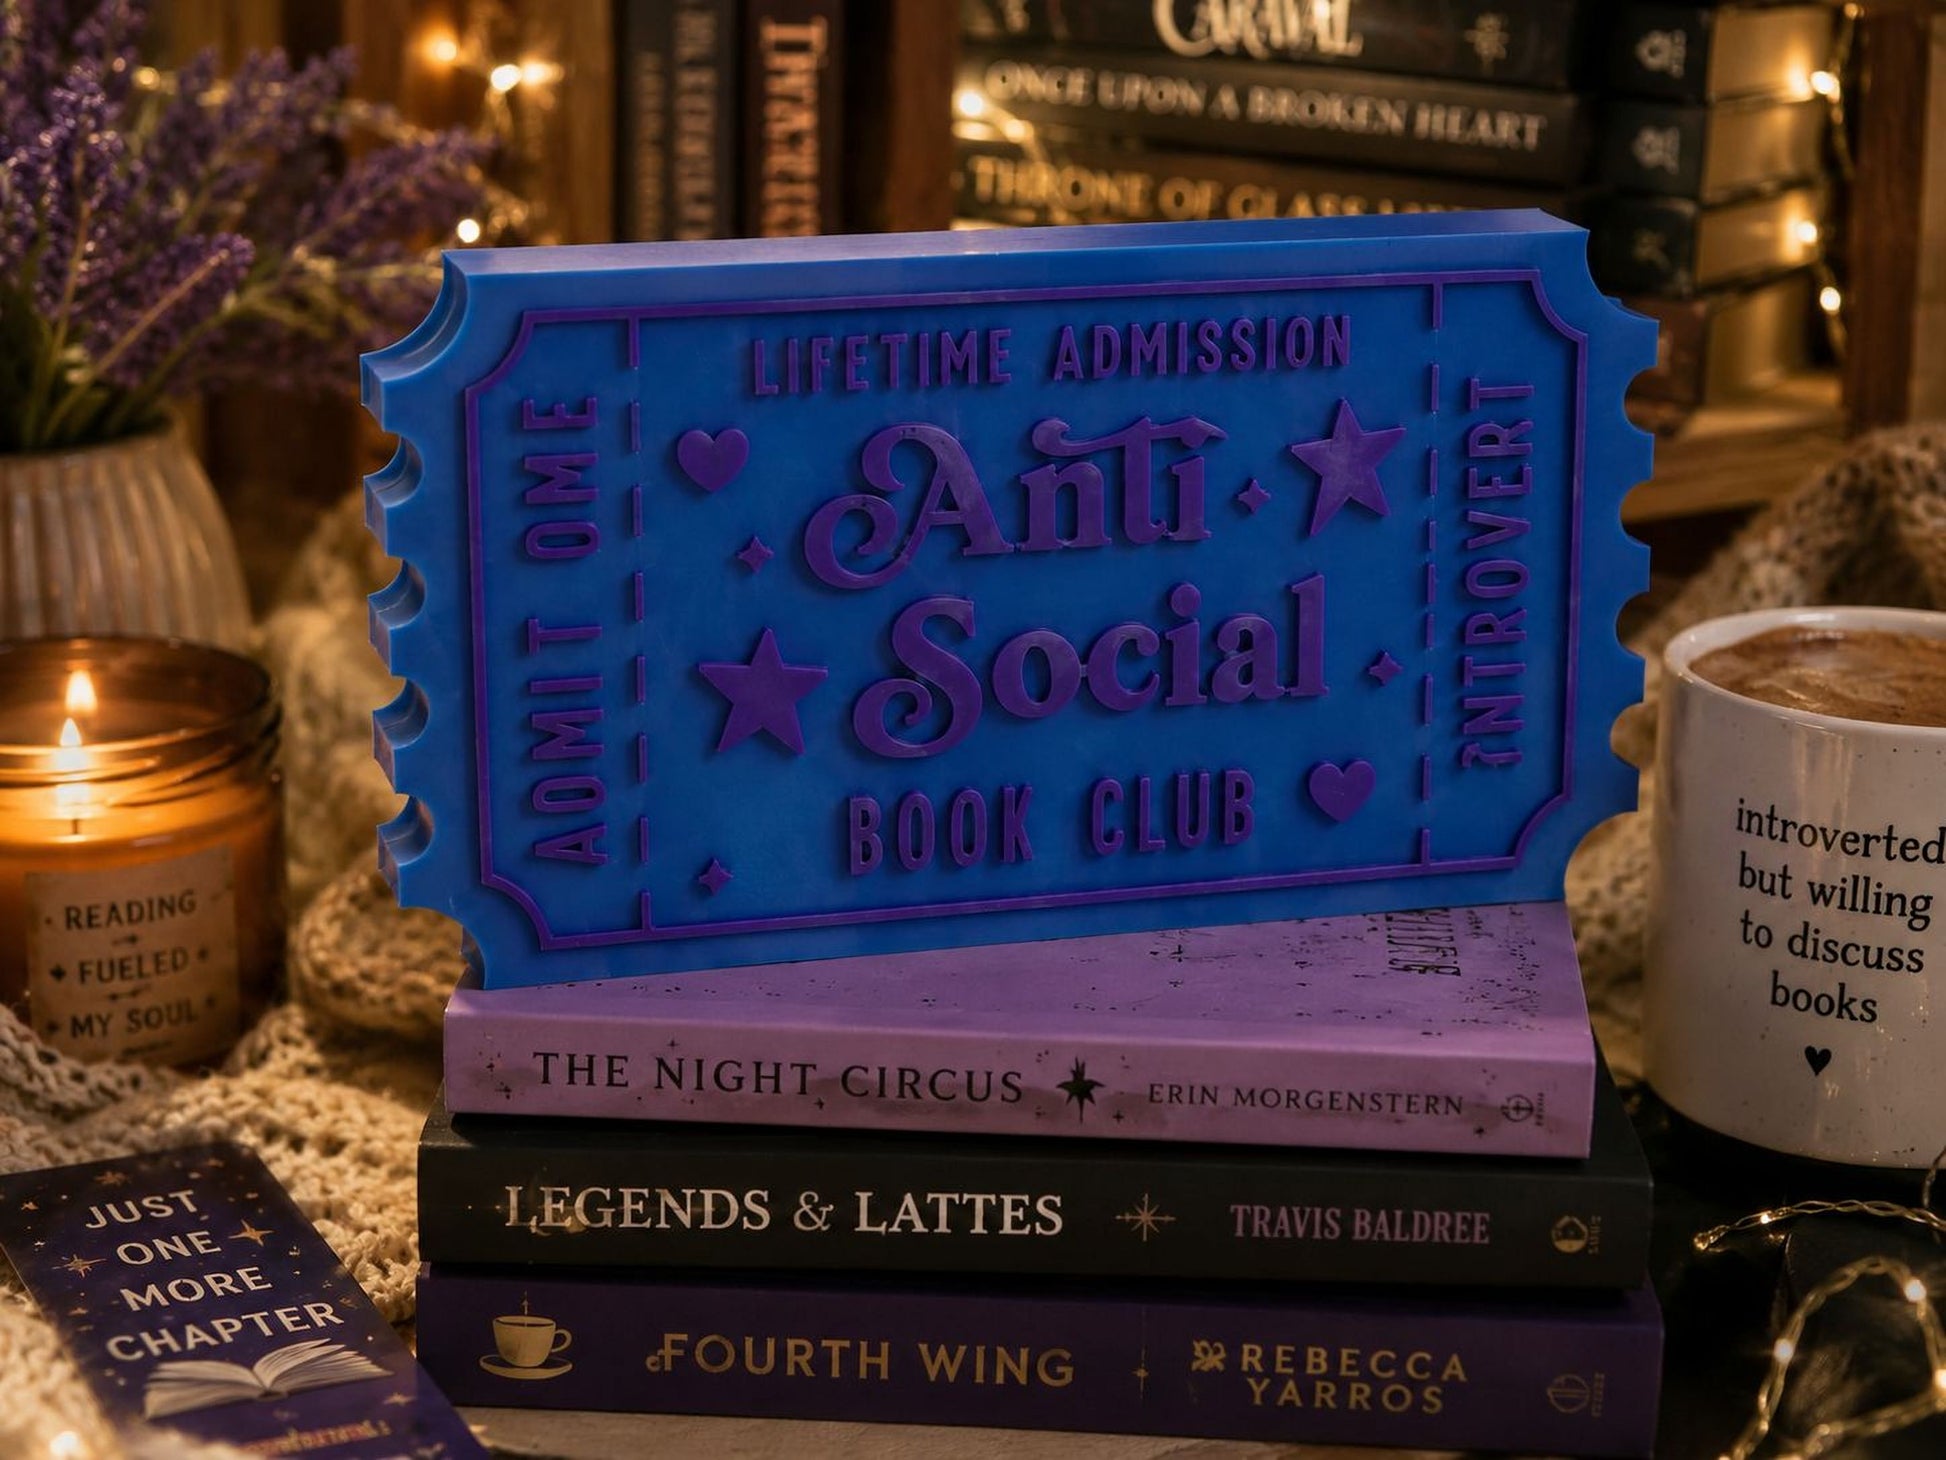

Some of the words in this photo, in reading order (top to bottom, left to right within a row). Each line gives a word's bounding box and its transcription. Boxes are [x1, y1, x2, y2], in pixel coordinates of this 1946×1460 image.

[985, 59, 1096, 107] ONCE
[1097, 69, 1207, 117] UPON
[1208, 83, 1240, 121] A
[1246, 84, 1407, 137] BROKEN
[1412, 101, 1548, 152] HEART
[1157, 176, 1224, 221] OF
[754, 327, 1012, 395] LIFETIME
[1053, 314, 1352, 382] ADMISSION
[804, 416, 1229, 590] Anti
[853, 573, 1330, 759] Social
[848, 782, 1034, 877] BOOK
[1091, 768, 1256, 856] CLUB
[1735, 797, 1946, 865] introverted
[64, 888, 197, 931] READING
[1738, 850, 1793, 900] but
[1807, 874, 1934, 932] willing
[78, 945, 190, 984] FUELED
[1740, 908, 1773, 949] to
[1787, 920, 1925, 974] discuss
[70, 1011, 114, 1039] MY
[126, 998, 200, 1034] SOUL
[1769, 968, 1878, 1024] books
[533, 1051, 630, 1088] THE
[654, 1056, 818, 1096] NIGHT
[841, 1065, 1023, 1103] CIRCUS
[1148, 1082, 1220, 1106] ERIN
[1232, 1087, 1465, 1117] MORGENSTERN
[84, 1188, 201, 1230] JUST
[504, 1185, 770, 1233] LEGENDS
[791, 1190, 835, 1232] &
[854, 1190, 1064, 1236] LATTES
[1230, 1204, 1341, 1241] TRAVIS
[1351, 1207, 1491, 1246] BALDREE
[115, 1229, 222, 1268] ONE
[119, 1265, 274, 1313] MORE
[105, 1301, 346, 1363] CHAPTER
[648, 1333, 891, 1381] FOURTH
[917, 1342, 1075, 1388] WING
[1240, 1343, 1468, 1383] REBECCA
[1246, 1376, 1444, 1415] YARROS
